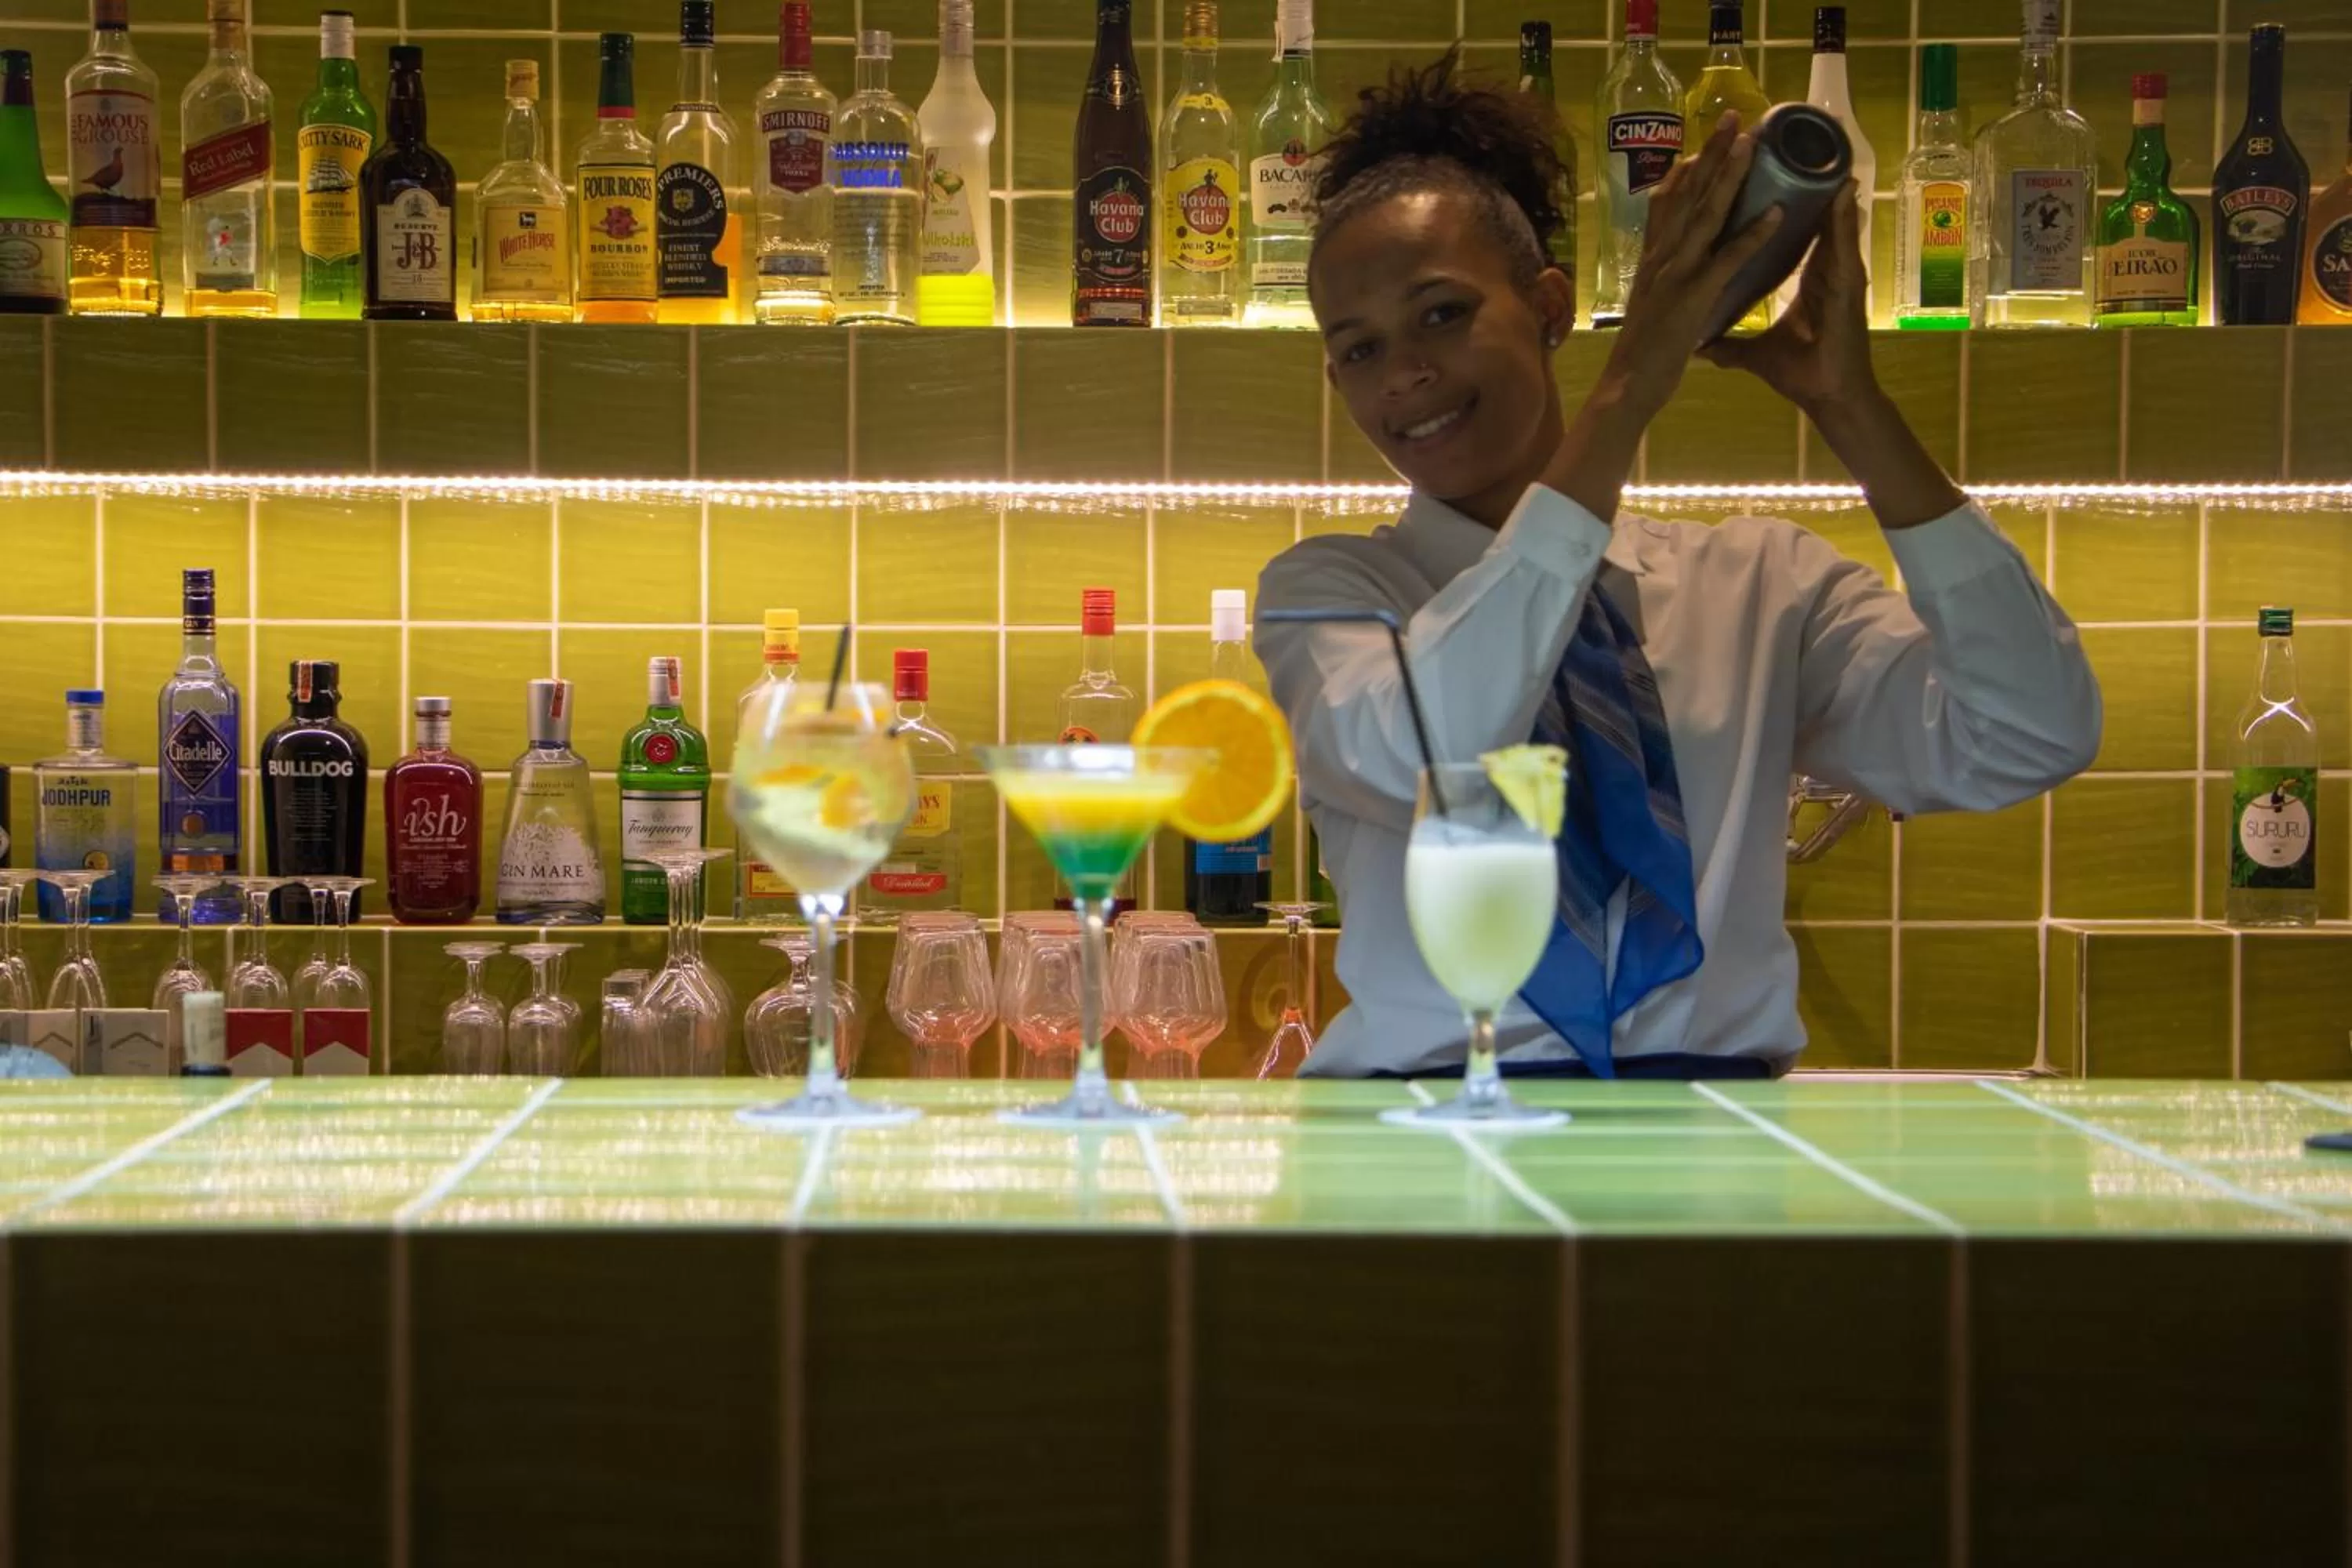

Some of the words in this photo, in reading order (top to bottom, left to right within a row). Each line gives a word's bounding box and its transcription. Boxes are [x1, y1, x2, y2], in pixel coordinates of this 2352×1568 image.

[77, 113, 149, 129] FAMOUS
[764, 113, 829, 130] SMIRNOFF
[77, 129, 149, 145] GROUSE
[1615, 122, 1682, 143] CINZANO
[188, 154, 214, 177] Red
[218, 141, 256, 168] Label
[833, 141, 909, 163] ABSOLUT
[1259, 169, 1318, 183] BACAR
[583, 176, 615, 201] FOUR
[617, 176, 653, 201] ROSES
[1088, 200, 1142, 216] Havana
[2225, 189, 2291, 212] BAILEYS
[1099, 217, 1134, 234] Club
[1189, 210, 1223, 226] Club
[499, 234, 528, 264] WHITE
[590, 244, 648, 255] BOURBON
[1204, 240, 1214, 255] 3
[1113, 249, 1124, 265] 7
[168, 739, 223, 761] Citadelle
[267, 759, 354, 778] BULLDOG
[42, 789, 111, 807] JODHPUR
[628, 820, 695, 838] Tanqueray
[2245, 820, 2307, 839] SURURU
[501, 864, 525, 878] GIN
[530, 864, 584, 879] MARE
